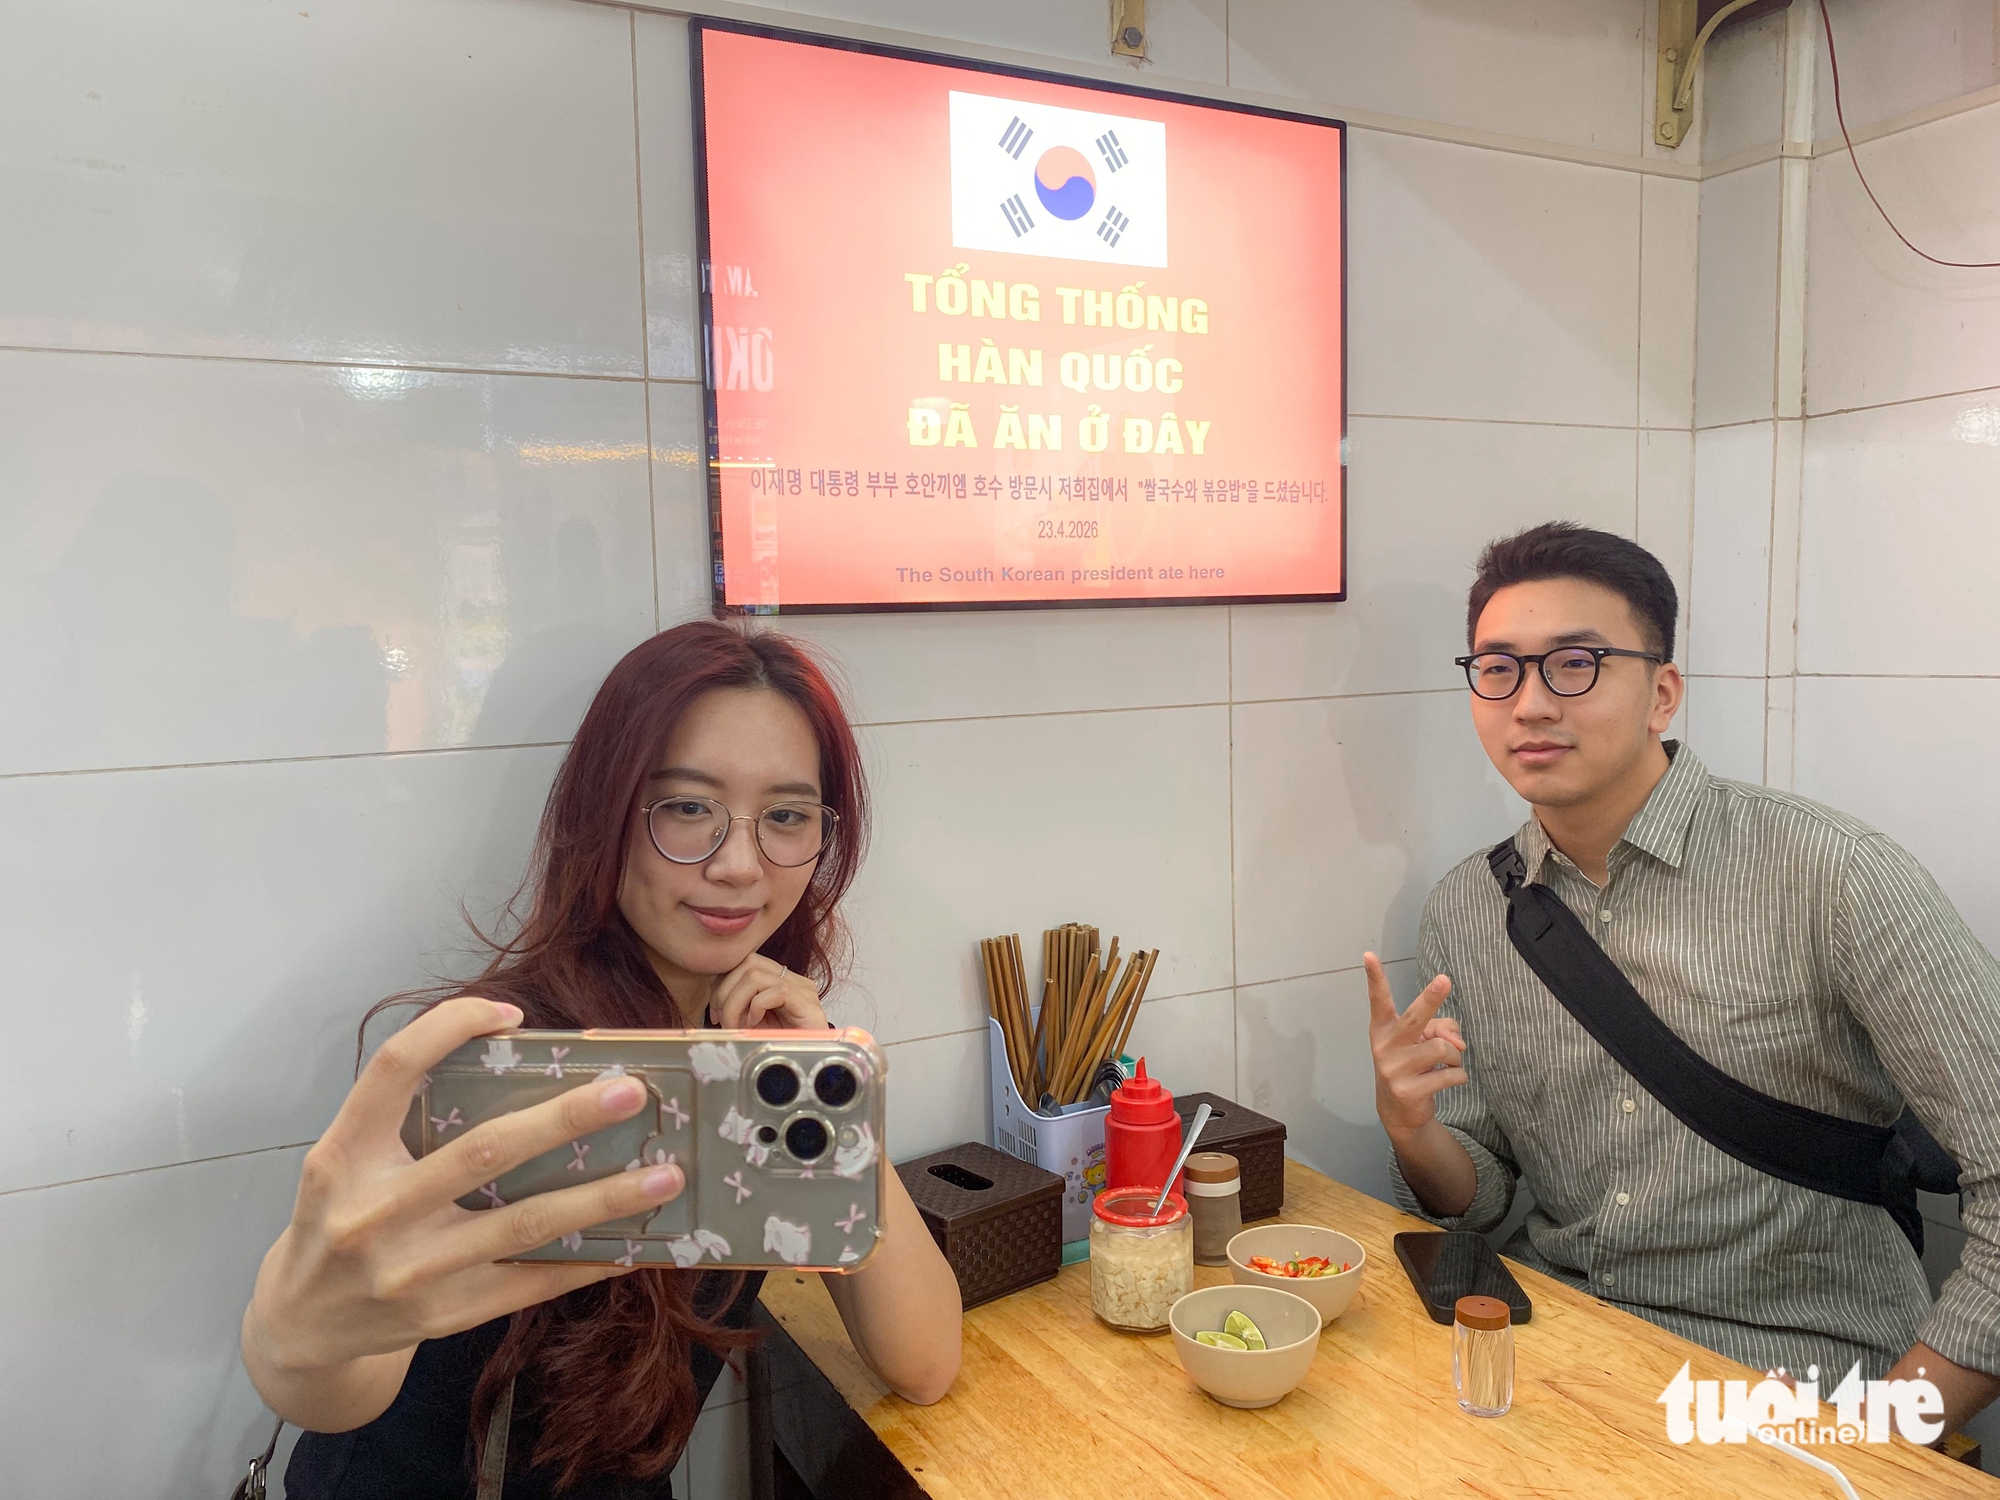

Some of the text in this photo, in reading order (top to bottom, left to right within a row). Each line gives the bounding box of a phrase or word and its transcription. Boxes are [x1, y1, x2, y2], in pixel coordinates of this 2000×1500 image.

[904, 262, 1209, 335] TỔNG THỐNG
[938, 338, 1184, 394] HÀN QUỐC
[906, 402, 1212, 455] ĐÃ ĂN Ở ĐÂY
[751, 467, 1328, 504] 이재명 대통령 부부 호안끼엠 호수 방문시 저희집에서 "쌀국수와 볶음밥"을 드셨습니다.
[1038, 520, 1098, 539] 23.4.2026
[896, 565, 1225, 584] The South Korean president ate here
